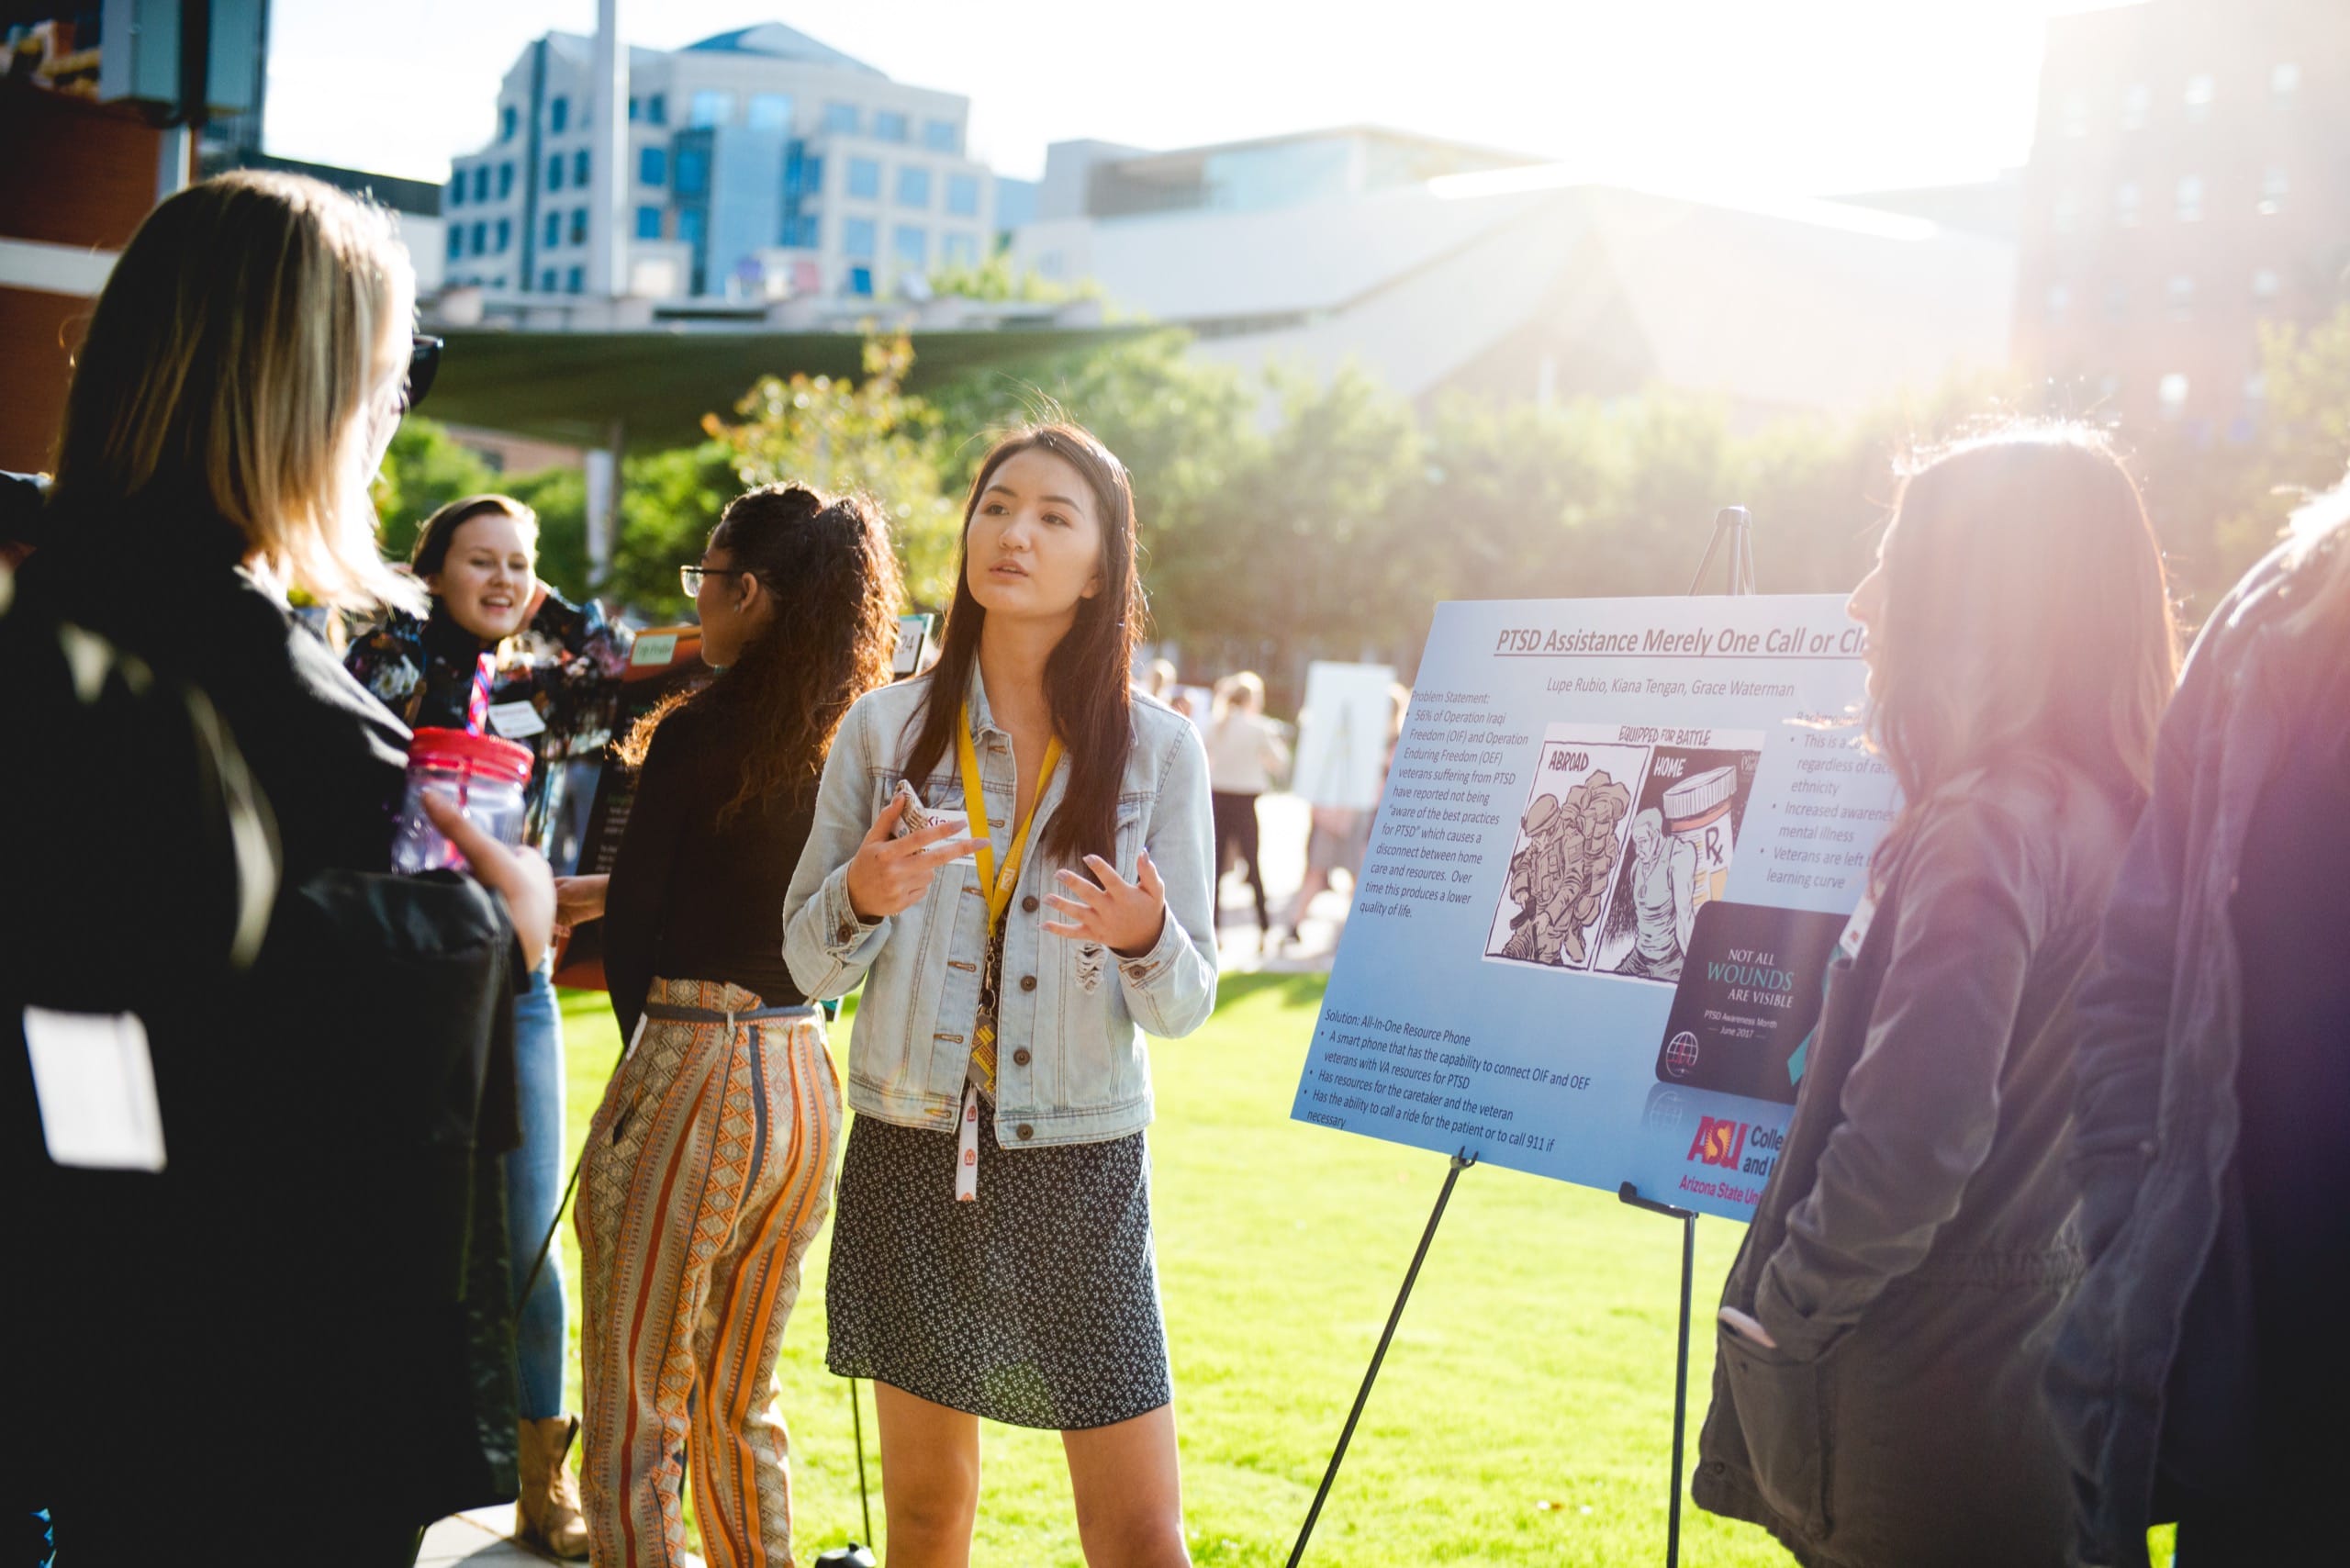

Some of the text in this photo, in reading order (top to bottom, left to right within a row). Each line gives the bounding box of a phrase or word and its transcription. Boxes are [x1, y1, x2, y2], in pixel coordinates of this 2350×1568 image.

[1497, 629, 1540, 651] PTSD
[1544, 628, 1638, 652] Assistance
[1643, 628, 1713, 656] Merely
[1718, 629, 1758, 653] One
[1766, 627, 1806, 653] Call
[1810, 632, 1833, 653] or
[1413, 690, 1490, 703] Problem Statement:
[1548, 677, 1794, 697] Lupe Rubio, Kiana Tengan, Grace Waterman
[1416, 709, 1506, 726] 56% of Operation Iraqi
[1410, 729, 1528, 745] Freedom (OIF) and Operation
[1619, 725, 1711, 745] EQUIPPED FOR BATTLE
[1805, 734, 1827, 748] This
[1829, 735, 1836, 748] is
[1840, 739, 1846, 748] a
[1404, 747, 1503, 766] Enduring Freedom (OEF)
[1549, 750, 1589, 771] ABROAD
[1797, 757, 1852, 772] regardless
[1856, 758, 1870, 773] of
[1399, 768, 1516, 785] veterans suffering from PTSD
[1654, 756, 1686, 778] HOME
[1393, 786, 1490, 803] have reported not being
[1792, 779, 1840, 796] ethnicity
[1417, 806, 1426, 818] of
[1428, 808, 1441, 819] the
[1443, 809, 1460, 821] best
[1462, 812, 1499, 824] practices
[1785, 801, 1839, 817] Increased
[1382, 823, 1393, 835] for
[1422, 827, 1444, 840] which
[1448, 832, 1473, 843] causes
[1476, 834, 1481, 844] a
[1779, 825, 1853, 842] mental illness
[1377, 843, 1483, 864] disconnect between home
[1774, 846, 1820, 862] Veterans
[1824, 854, 1841, 864] are
[1844, 852, 1863, 867] left
[1371, 863, 1472, 883] care and resources. Over
[1767, 868, 1845, 889] learning curve
[1366, 881, 1383, 893] time
[1385, 882, 1399, 895] this
[1401, 886, 1438, 901] produces
[1448, 890, 1472, 903] lower
[1360, 901, 1412, 917] quality of life.
[1729, 948, 1774, 965] NOT ALL
[1707, 961, 1794, 991] WOUNDS
[1729, 989, 1794, 1008] ARE VISIBLE
[1705, 1009, 1720, 1020] PTSD
[1326, 1010, 1470, 1046] Solution: All-In-One Resource Phone
[1720, 1026, 1753, 1038] June 2017
[1330, 1030, 1590, 1090] A smart phone that has the capability to connect OIF and OEF
[1325, 1051, 1469, 1090] veterans with VA resources for PTSD
[1319, 1070, 1513, 1120] Has resources for the caretaker and the veteran
[1308, 1110, 1346, 1129] necessary
[1314, 1089, 1555, 1151] Has the ability to call a ride for the patient or to call 911 if
[1688, 1116, 1749, 1170] ASU
[1751, 1126, 1783, 1151] Colle
[1744, 1157, 1769, 1176] and
[1680, 1174, 1717, 1195] Arizona
[1718, 1182, 1744, 1202] State
